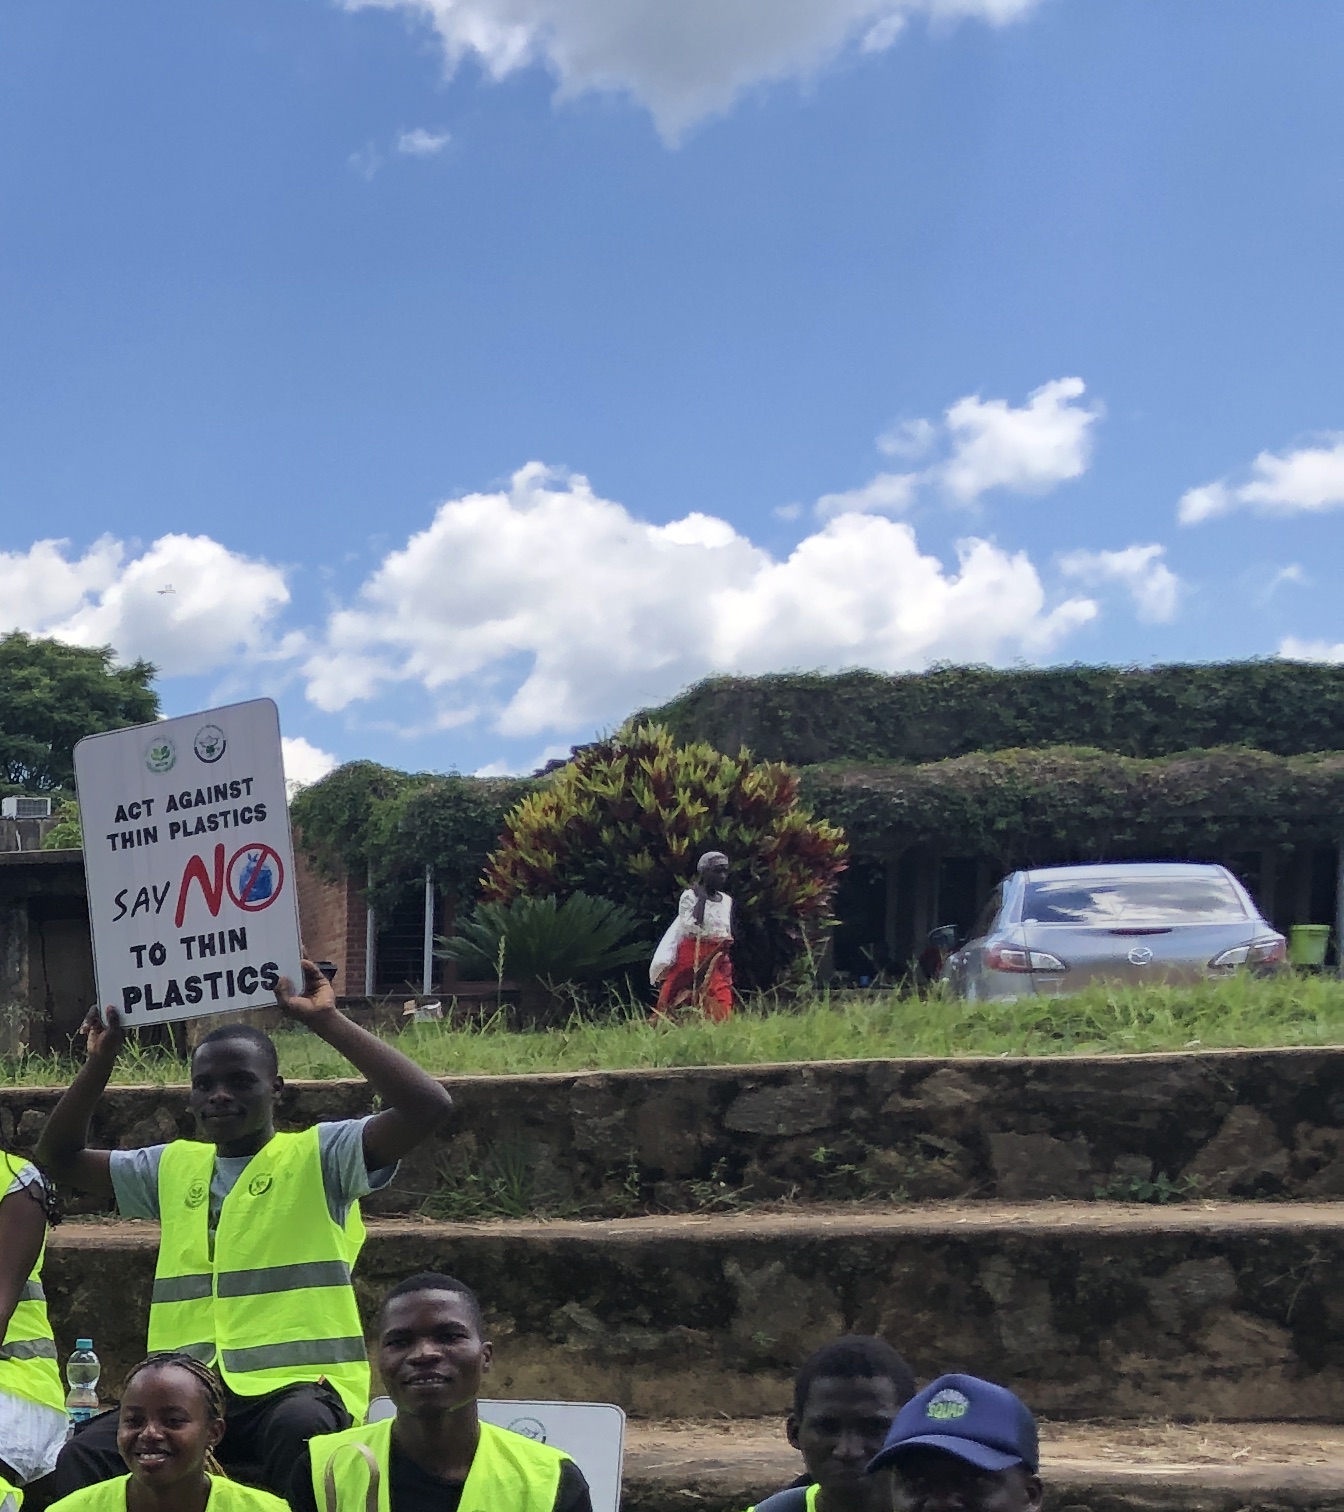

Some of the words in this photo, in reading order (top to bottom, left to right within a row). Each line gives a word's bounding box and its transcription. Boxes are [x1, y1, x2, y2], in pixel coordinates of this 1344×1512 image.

[114, 798, 154, 824] ACT
[165, 777, 254, 814] AGAINST
[106, 825, 158, 851] THIN
[169, 803, 267, 840] PLASTICS
[112, 880, 171, 922] SAY
[129, 941, 167, 969] TO
[180, 926, 248, 961] THIN
[121, 961, 280, 1015] PLASTICS
